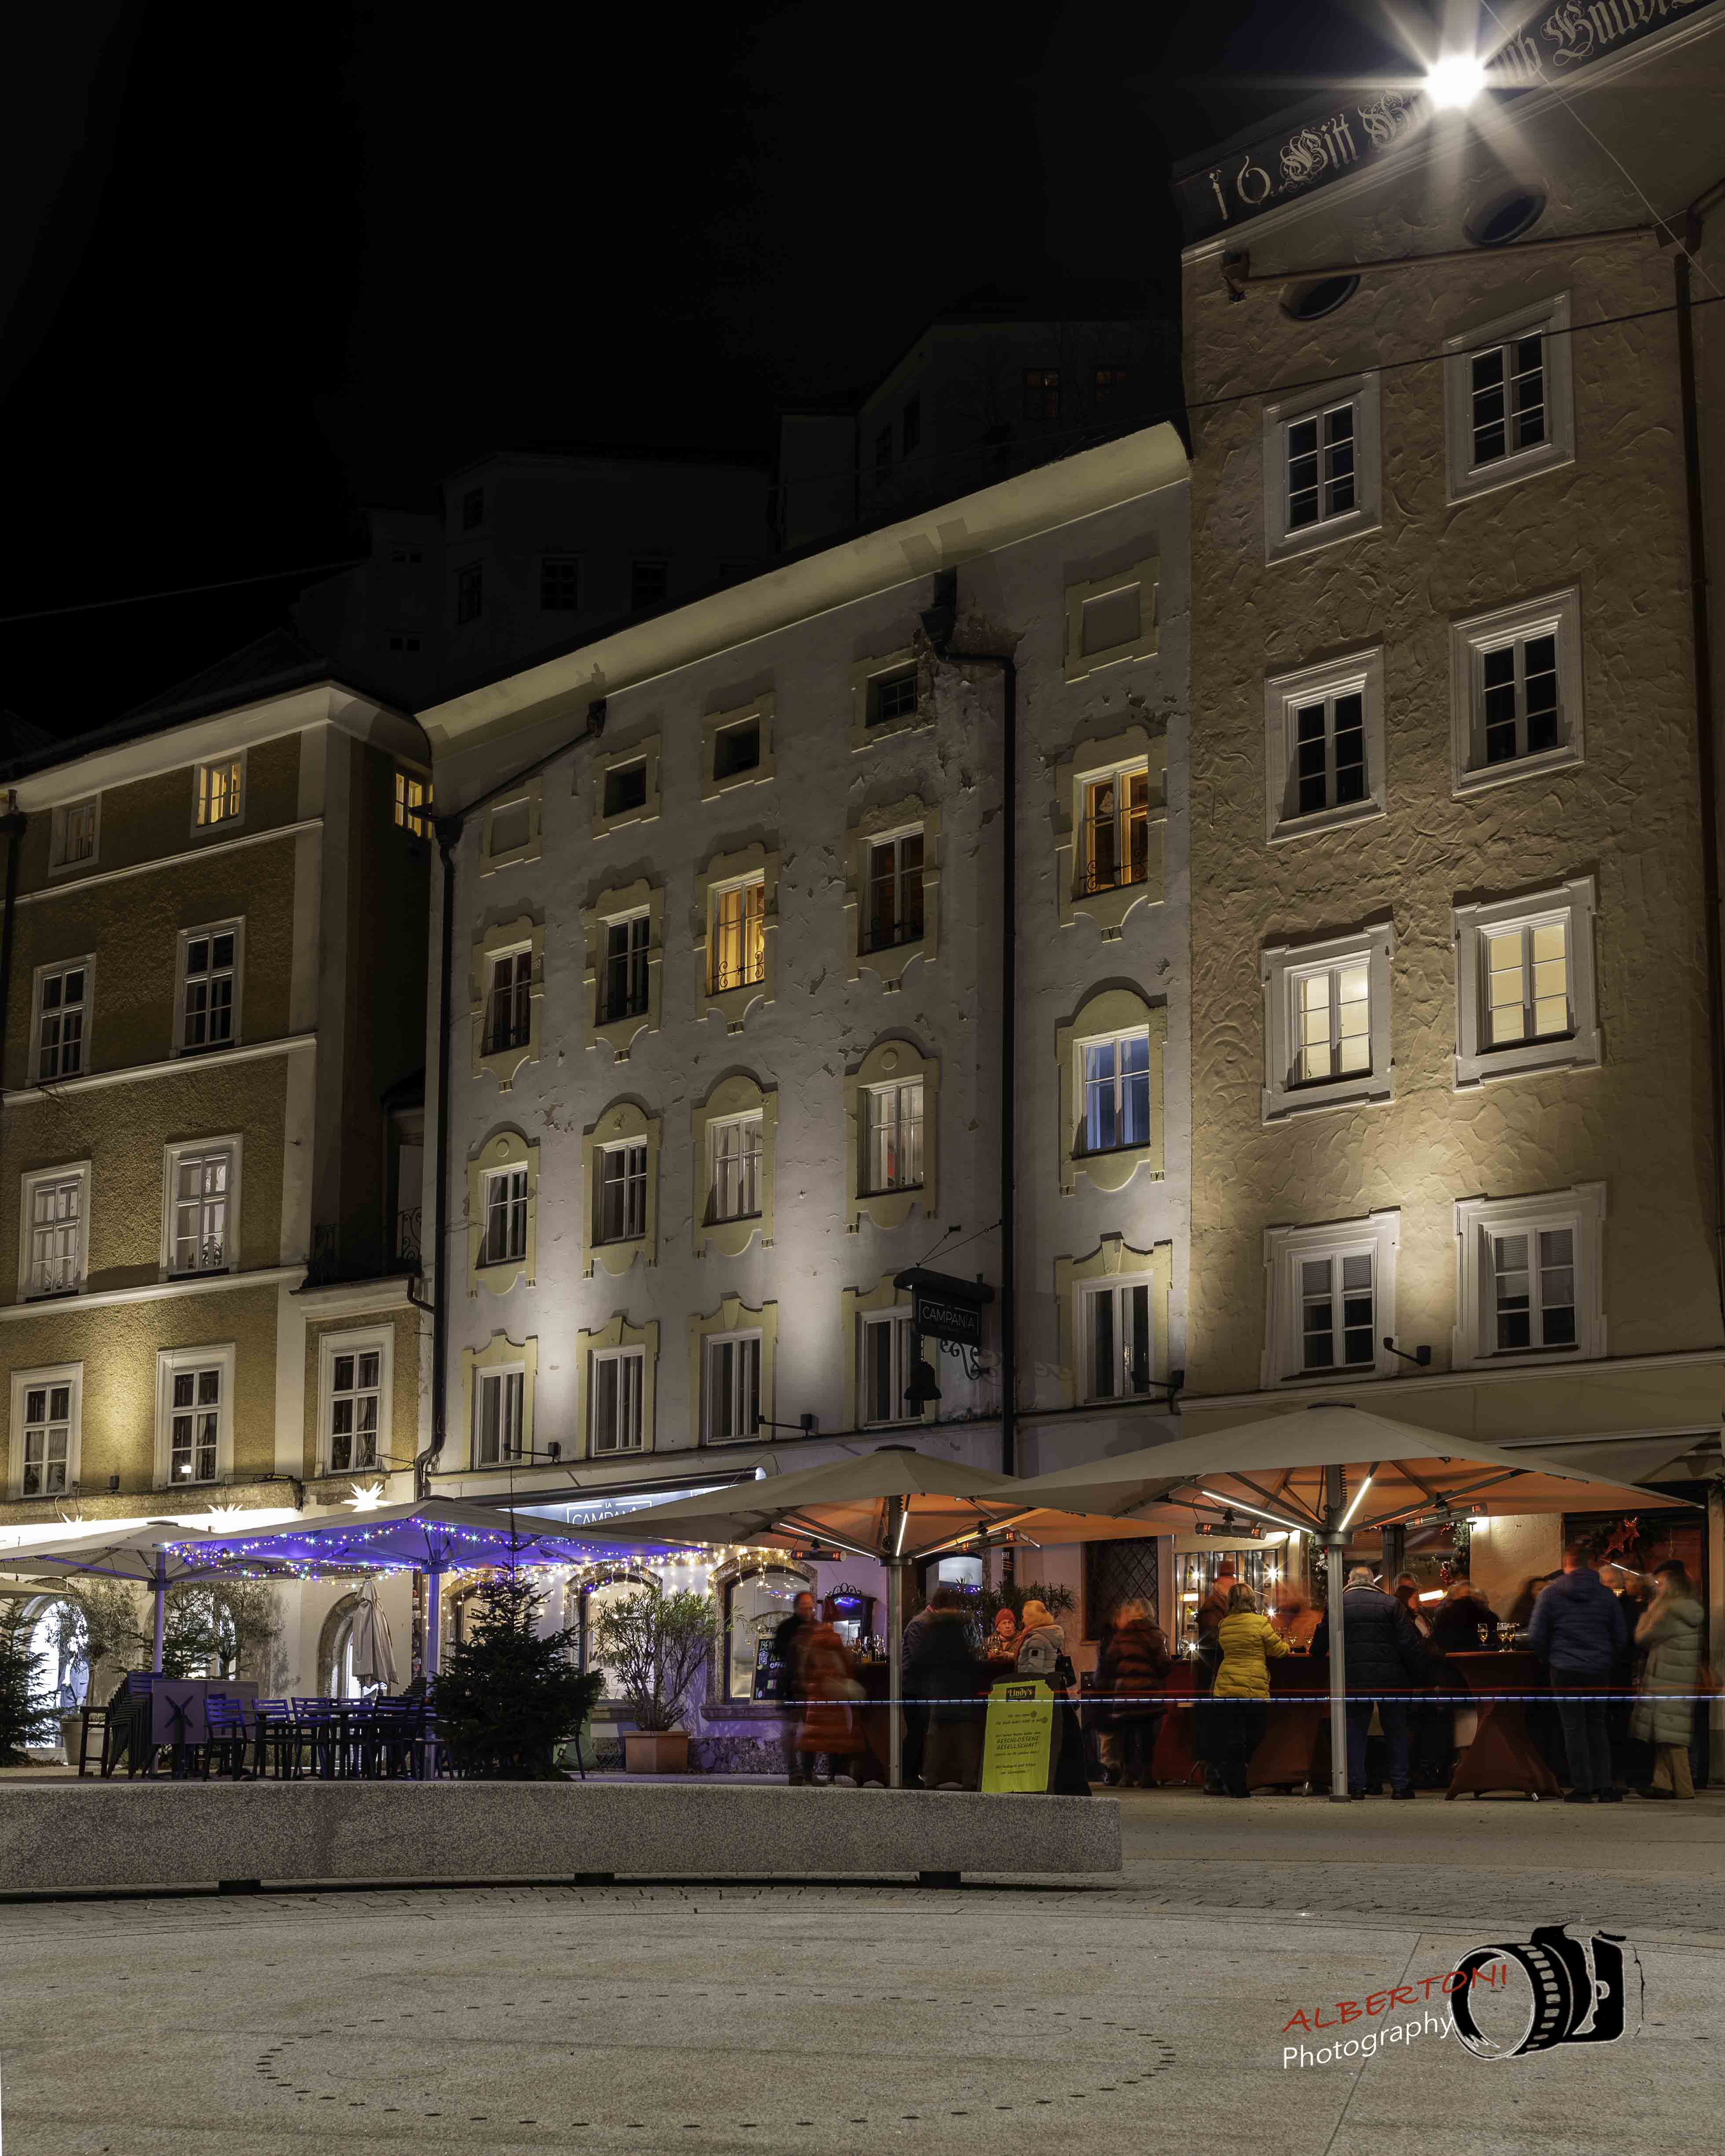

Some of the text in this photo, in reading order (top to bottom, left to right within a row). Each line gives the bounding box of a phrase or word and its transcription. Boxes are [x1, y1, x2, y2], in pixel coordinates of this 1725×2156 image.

[922, 1306, 975, 1328] CAMPANIA
[1009, 1688, 1032, 1697] Lindy's
[996, 1736, 1039, 1744] GESCHLOSSENE
[996, 1741, 1039, 1750] GESELLSCHAFT
